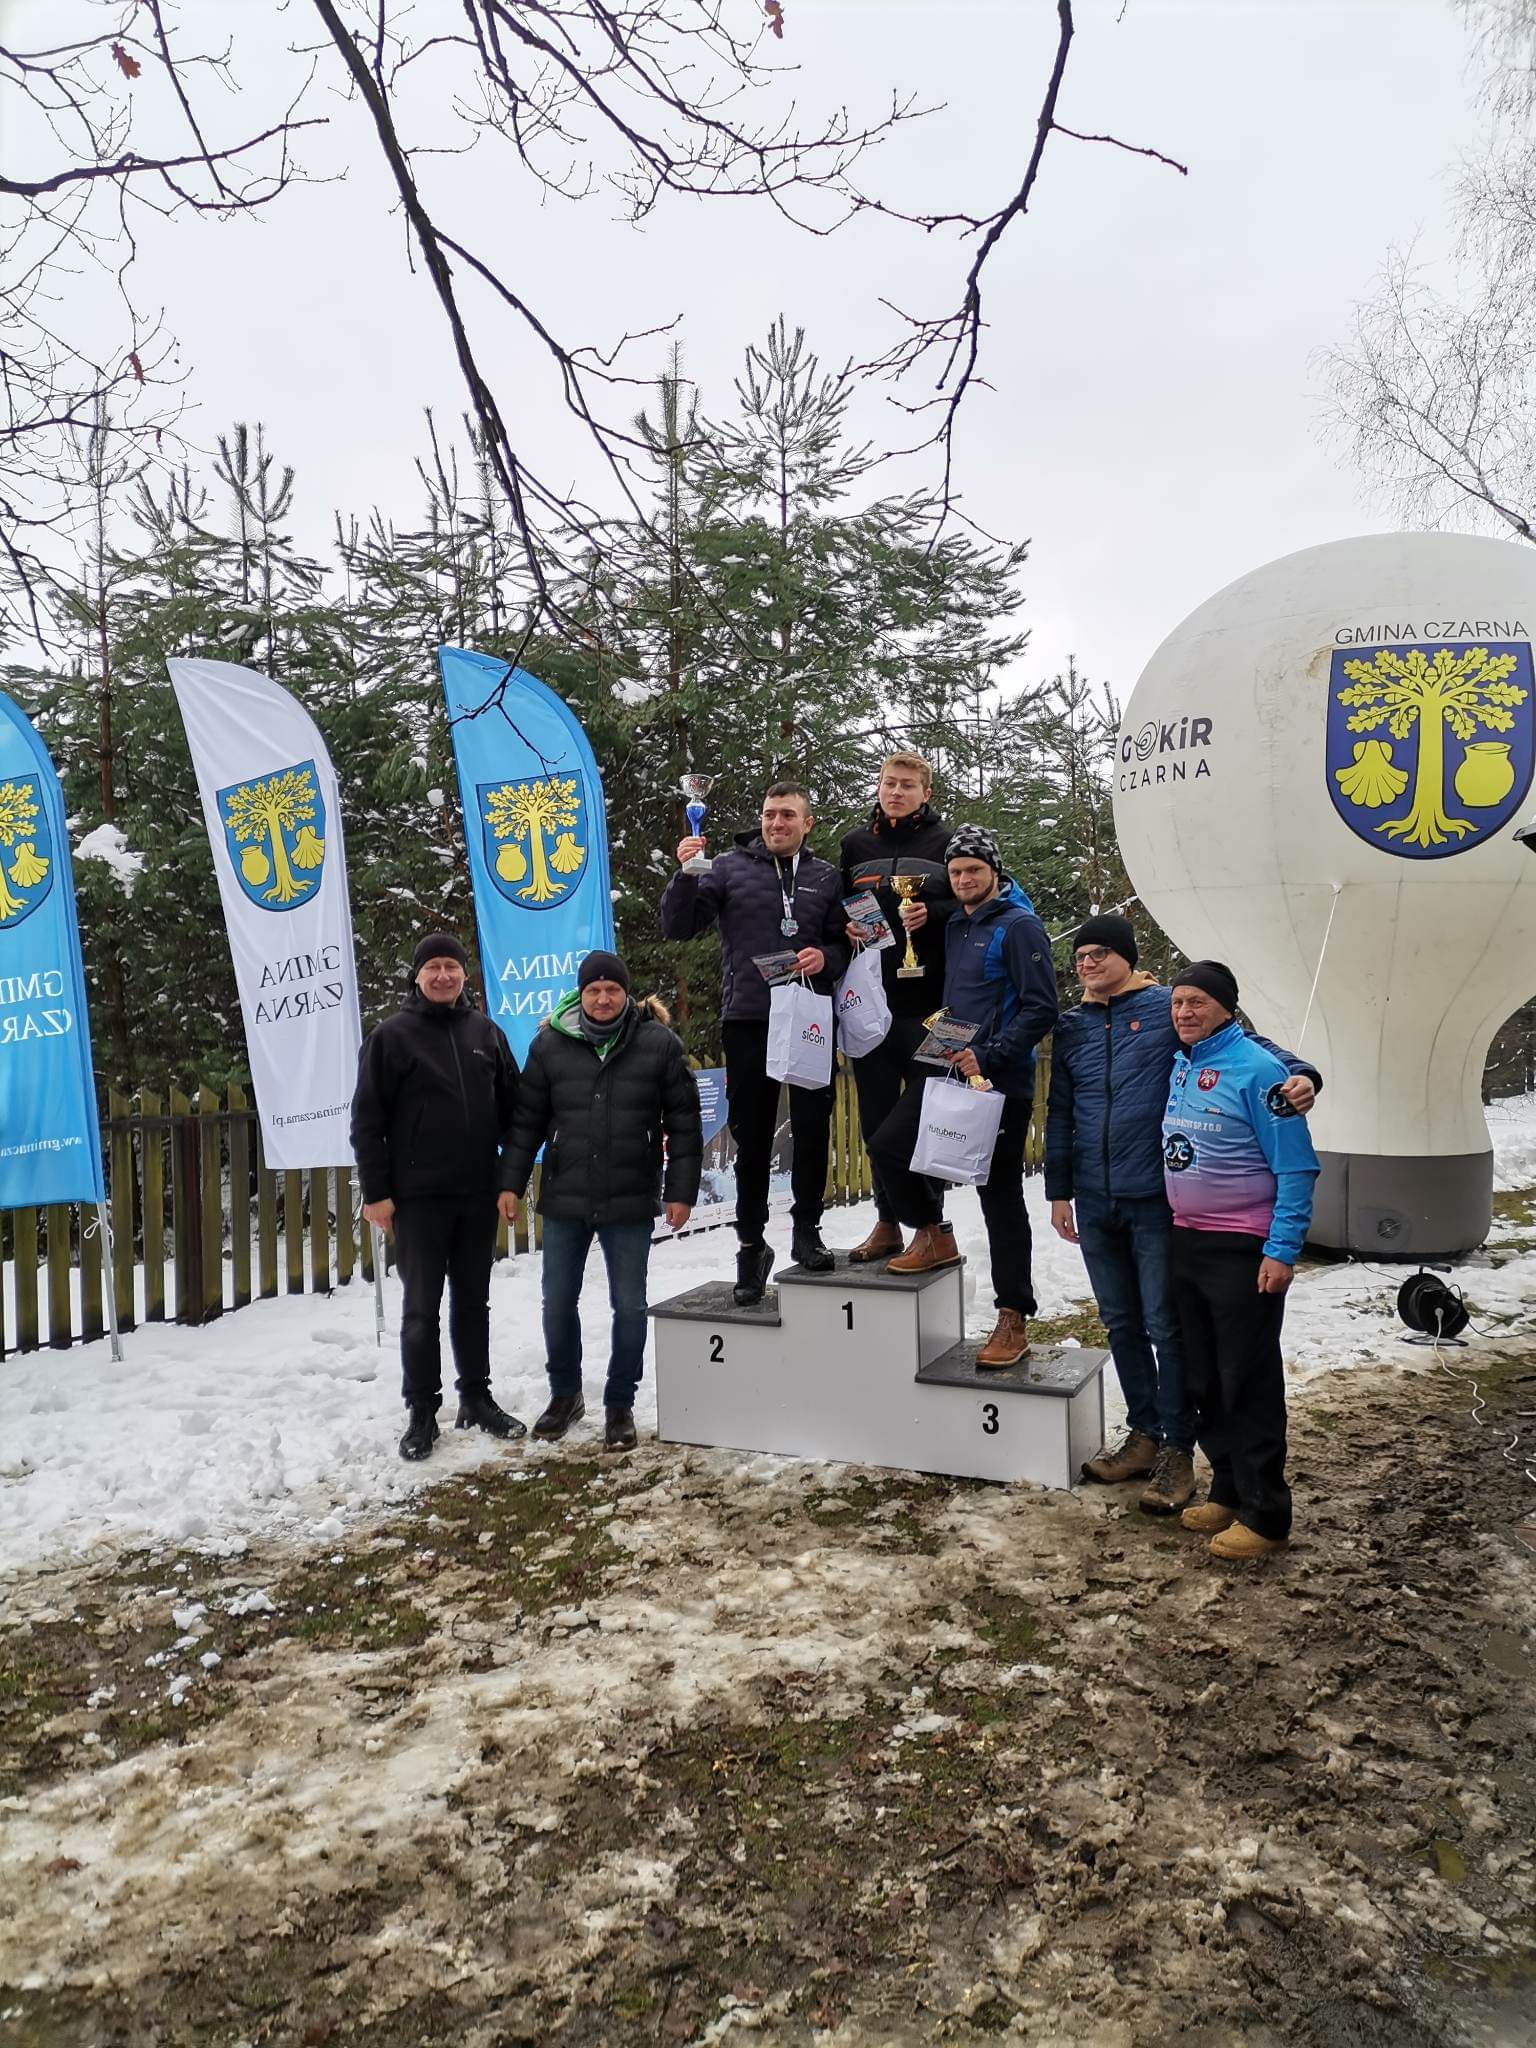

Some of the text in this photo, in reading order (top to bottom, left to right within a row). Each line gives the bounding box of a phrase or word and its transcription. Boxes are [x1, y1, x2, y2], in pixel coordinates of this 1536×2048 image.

[1335, 621, 1529, 645] GMINA CZARNA
[1120, 759, 1211, 792] CZARNA
[840, 995, 862, 1013] sicon
[802, 1028, 825, 1046] sicon
[841, 1301, 854, 1330] 1
[709, 1334, 725, 1363] 2
[982, 1404, 1000, 1434] 3
